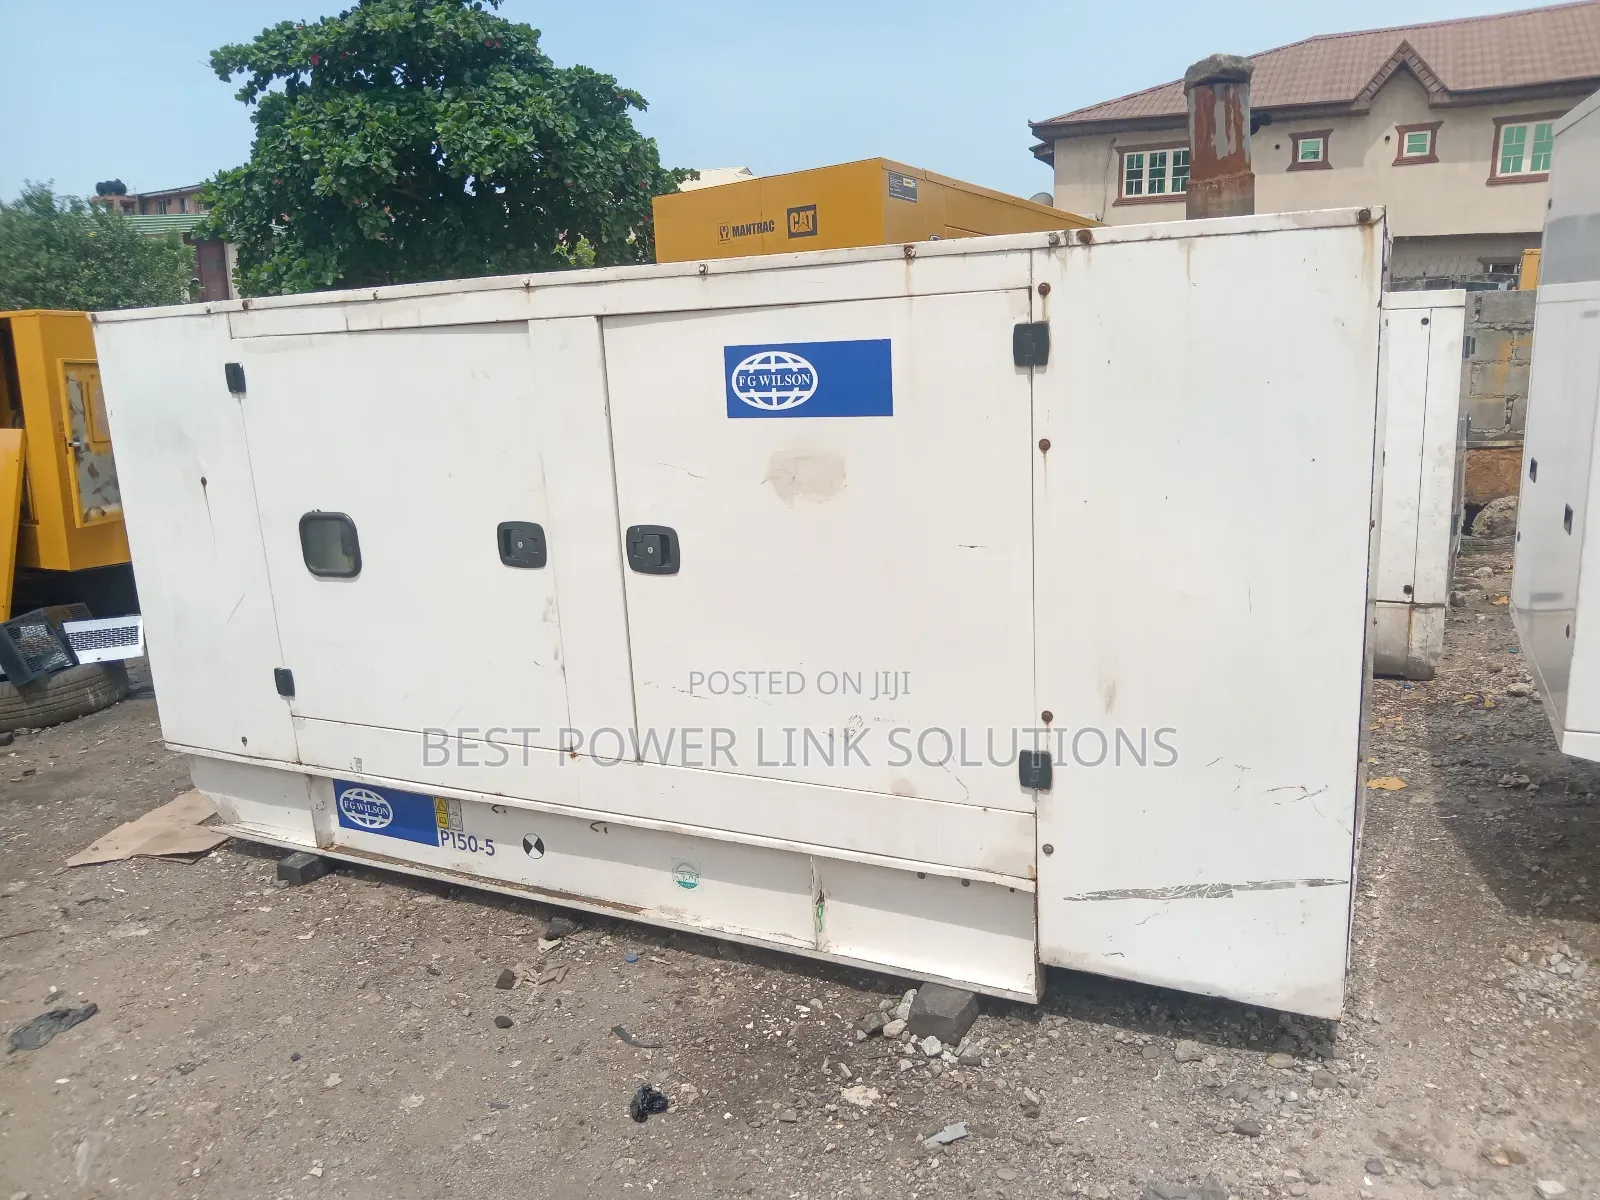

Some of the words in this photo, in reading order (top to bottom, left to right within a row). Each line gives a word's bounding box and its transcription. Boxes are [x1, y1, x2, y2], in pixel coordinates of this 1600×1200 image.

[732, 220, 775, 238] MANTRAC
[790, 210, 815, 234] CAT
[759, 373, 811, 387] WILSON
[357, 802, 389, 816] WILSON
[440, 830, 496, 857] P150-5
